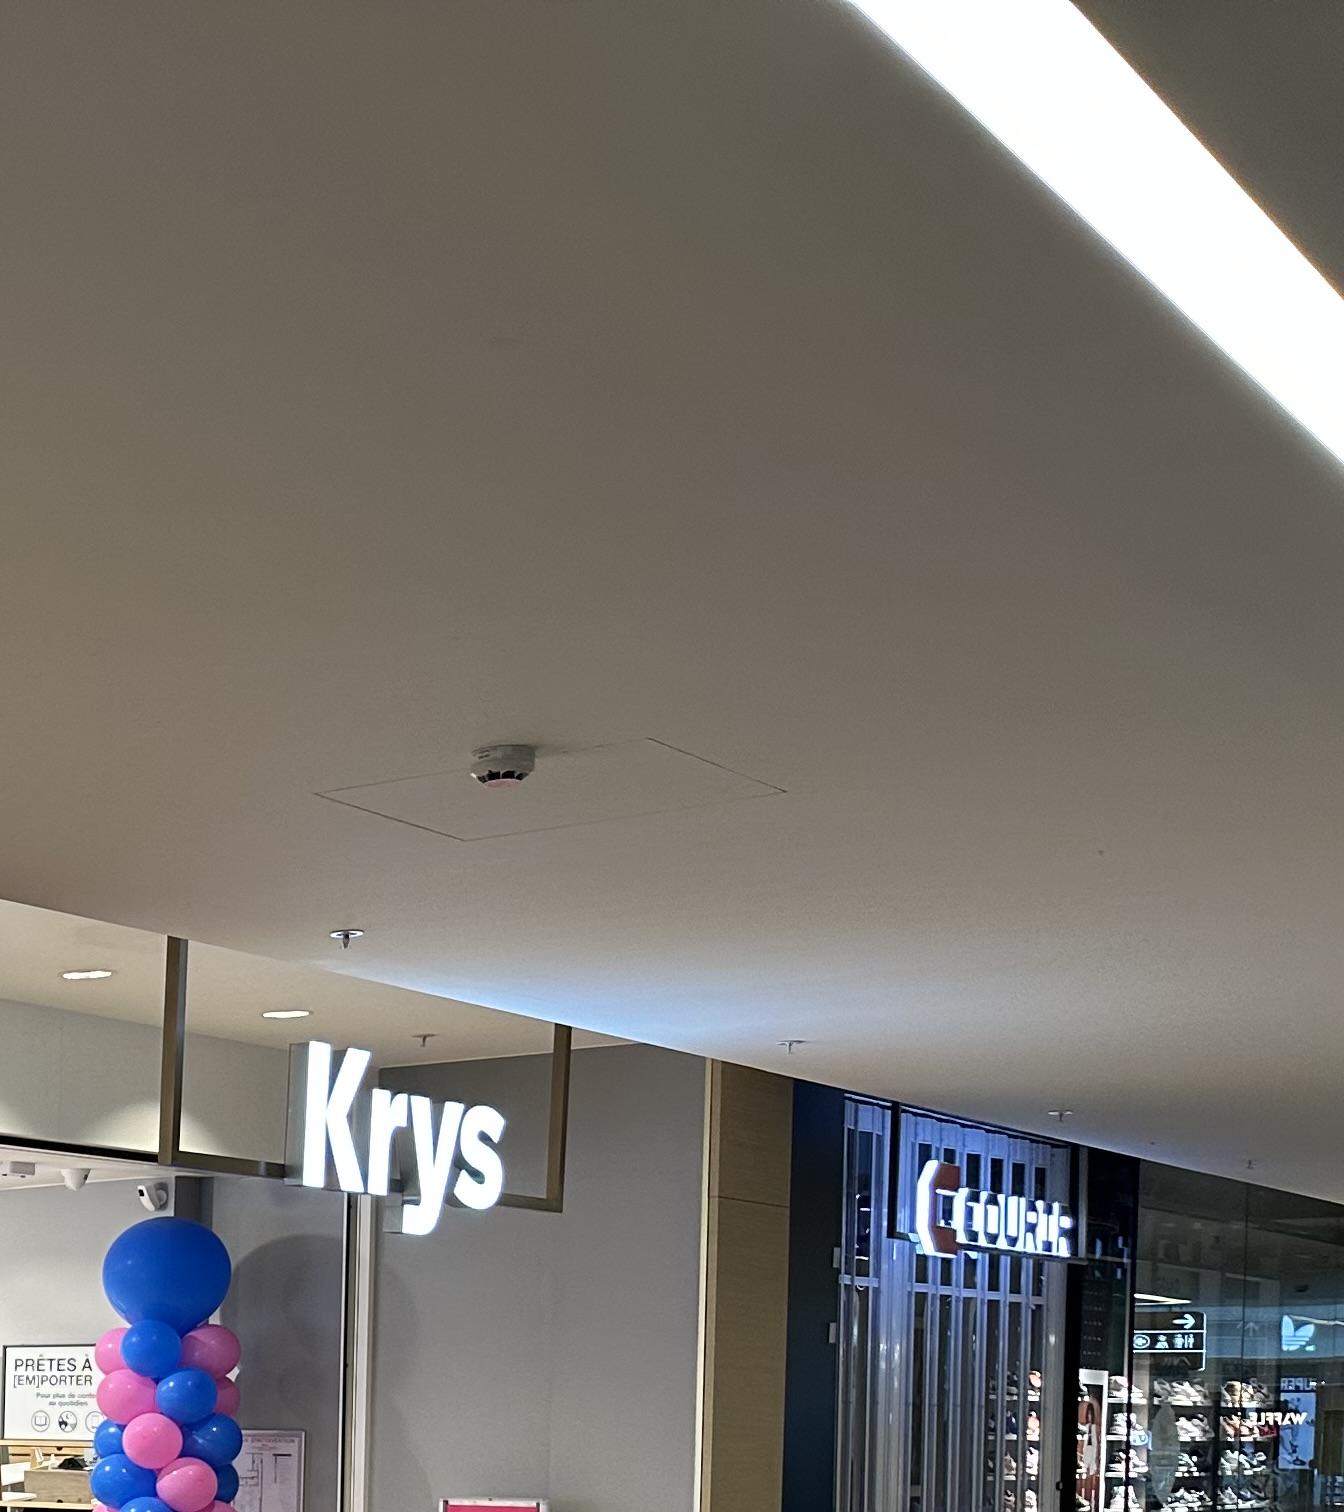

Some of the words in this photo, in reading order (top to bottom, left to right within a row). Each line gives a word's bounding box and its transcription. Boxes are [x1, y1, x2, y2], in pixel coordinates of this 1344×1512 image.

[302, 1039, 506, 1236] Krys
[14, 1353, 77, 1372] PRÊTES
[81, 1353, 93, 1372] À
[13, 1374, 93, 1388] [EM]PORTER
